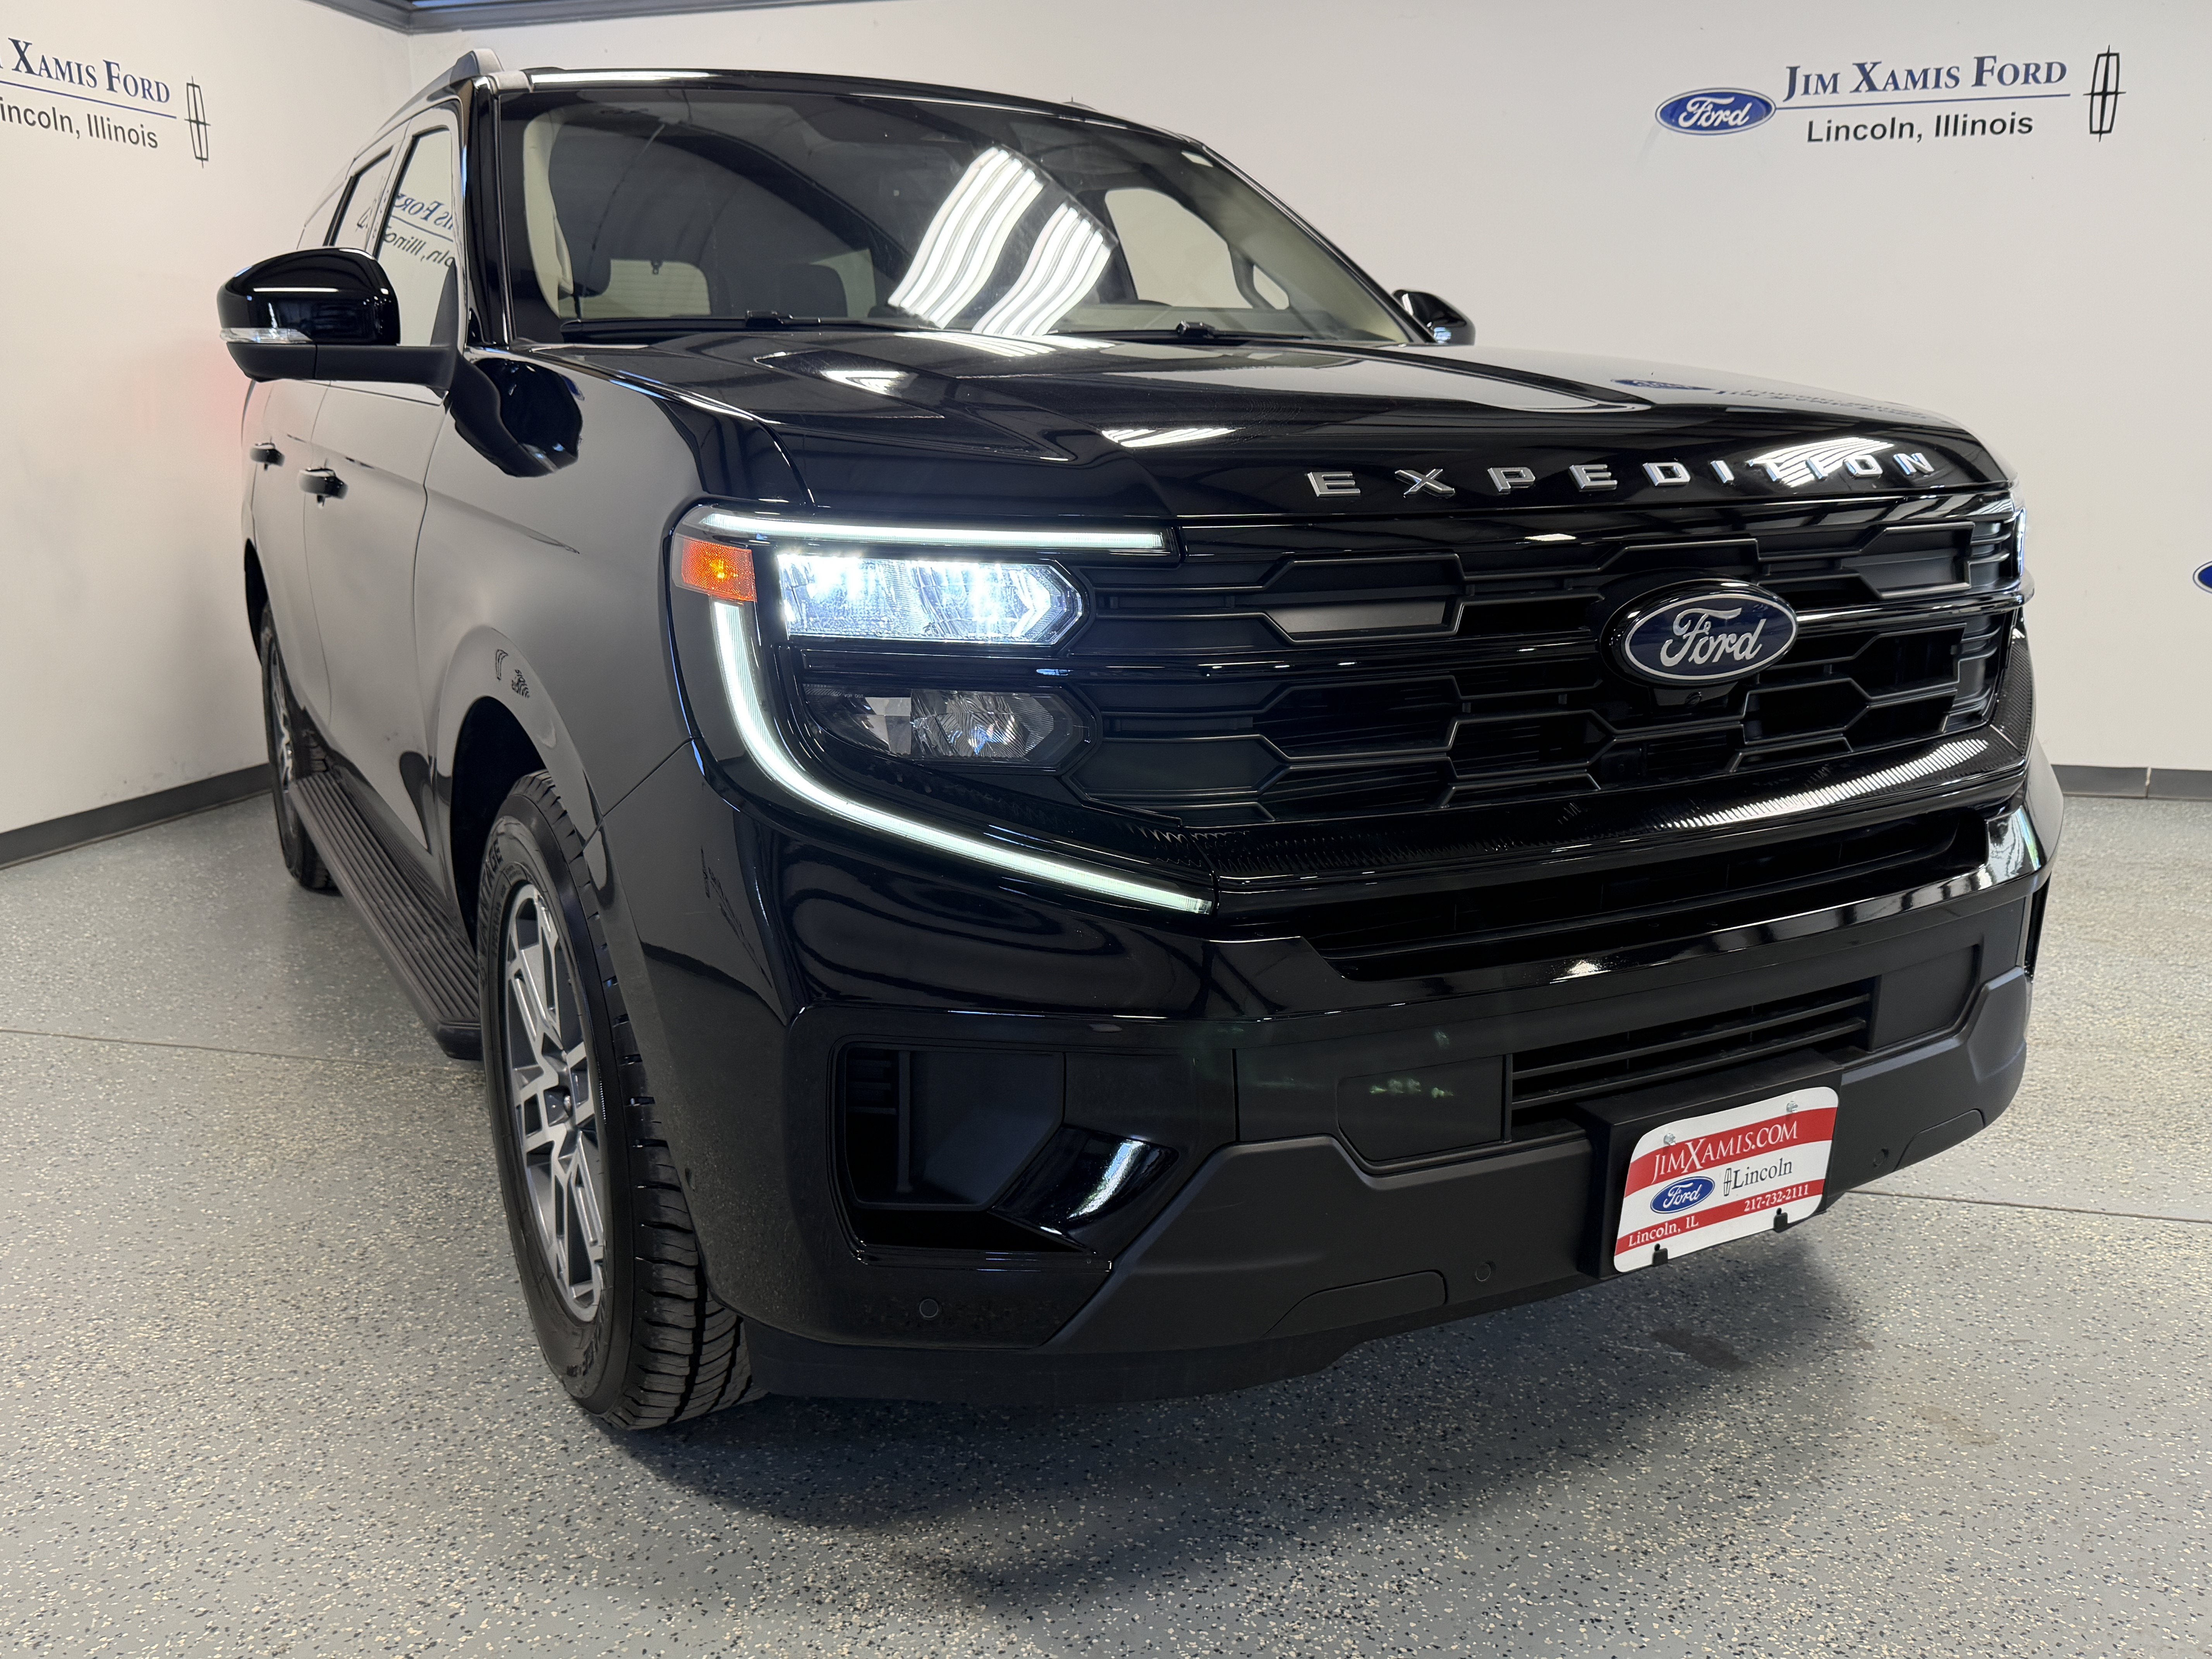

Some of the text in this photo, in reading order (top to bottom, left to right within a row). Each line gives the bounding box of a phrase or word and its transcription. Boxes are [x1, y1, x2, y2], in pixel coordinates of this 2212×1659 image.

[0, 96, 158, 149] incoln, Illinois
[1678, 96, 1753, 128] Ford
[1807, 111, 2033, 143] Lincoln, Illinois
[1307, 452, 1935, 499] EXPEDITION
[1660, 607, 1767, 667] Ford
[1652, 1121, 1798, 1183] JIMXAMIS.COM
[1733, 1158, 1792, 1189] Lincoln
[1662, 1183, 1701, 1209] Ford
[1744, 1184, 1809, 1212] 217-732-2111
[1628, 1216, 1699, 1247] Lincoln, IL
